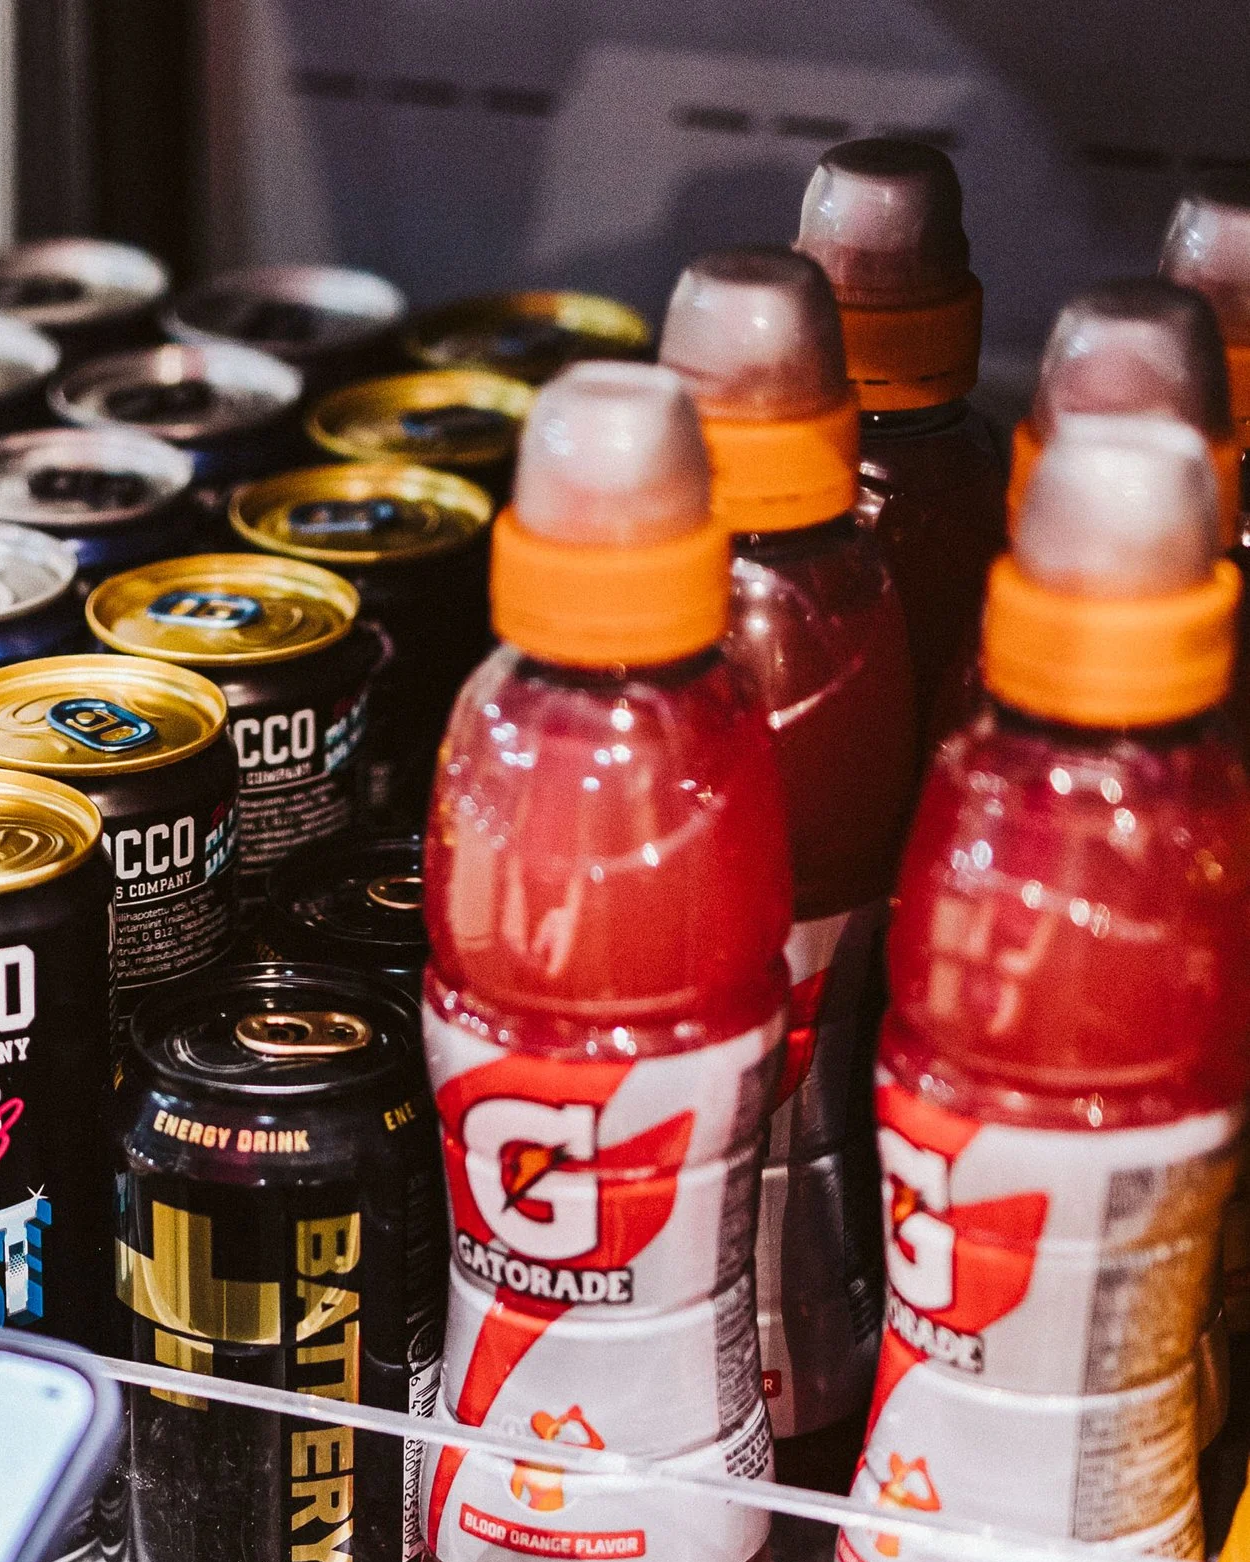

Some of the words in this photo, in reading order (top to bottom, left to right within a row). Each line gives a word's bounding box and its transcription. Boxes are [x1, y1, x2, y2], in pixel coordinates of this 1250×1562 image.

[234, 707, 316, 768] CCO
[102, 815, 195, 880] CCO
[129, 870, 192, 898] COMPANY
[153, 1109, 231, 1150] ENERGY
[236, 1129, 310, 1153] DRINK
[383, 1102, 416, 1132] ENE
[463, 1098, 598, 1260] G
[457, 1234, 631, 1302] GATORADE
[886, 1296, 984, 1374] ORADE
[404, 1399, 421, 1474] 4600
[403, 1478, 418, 1545] 025300
[464, 1510, 507, 1541] BLOOD
[509, 1529, 571, 1553] ORANGE
[575, 1536, 639, 1554] FLAVOR
